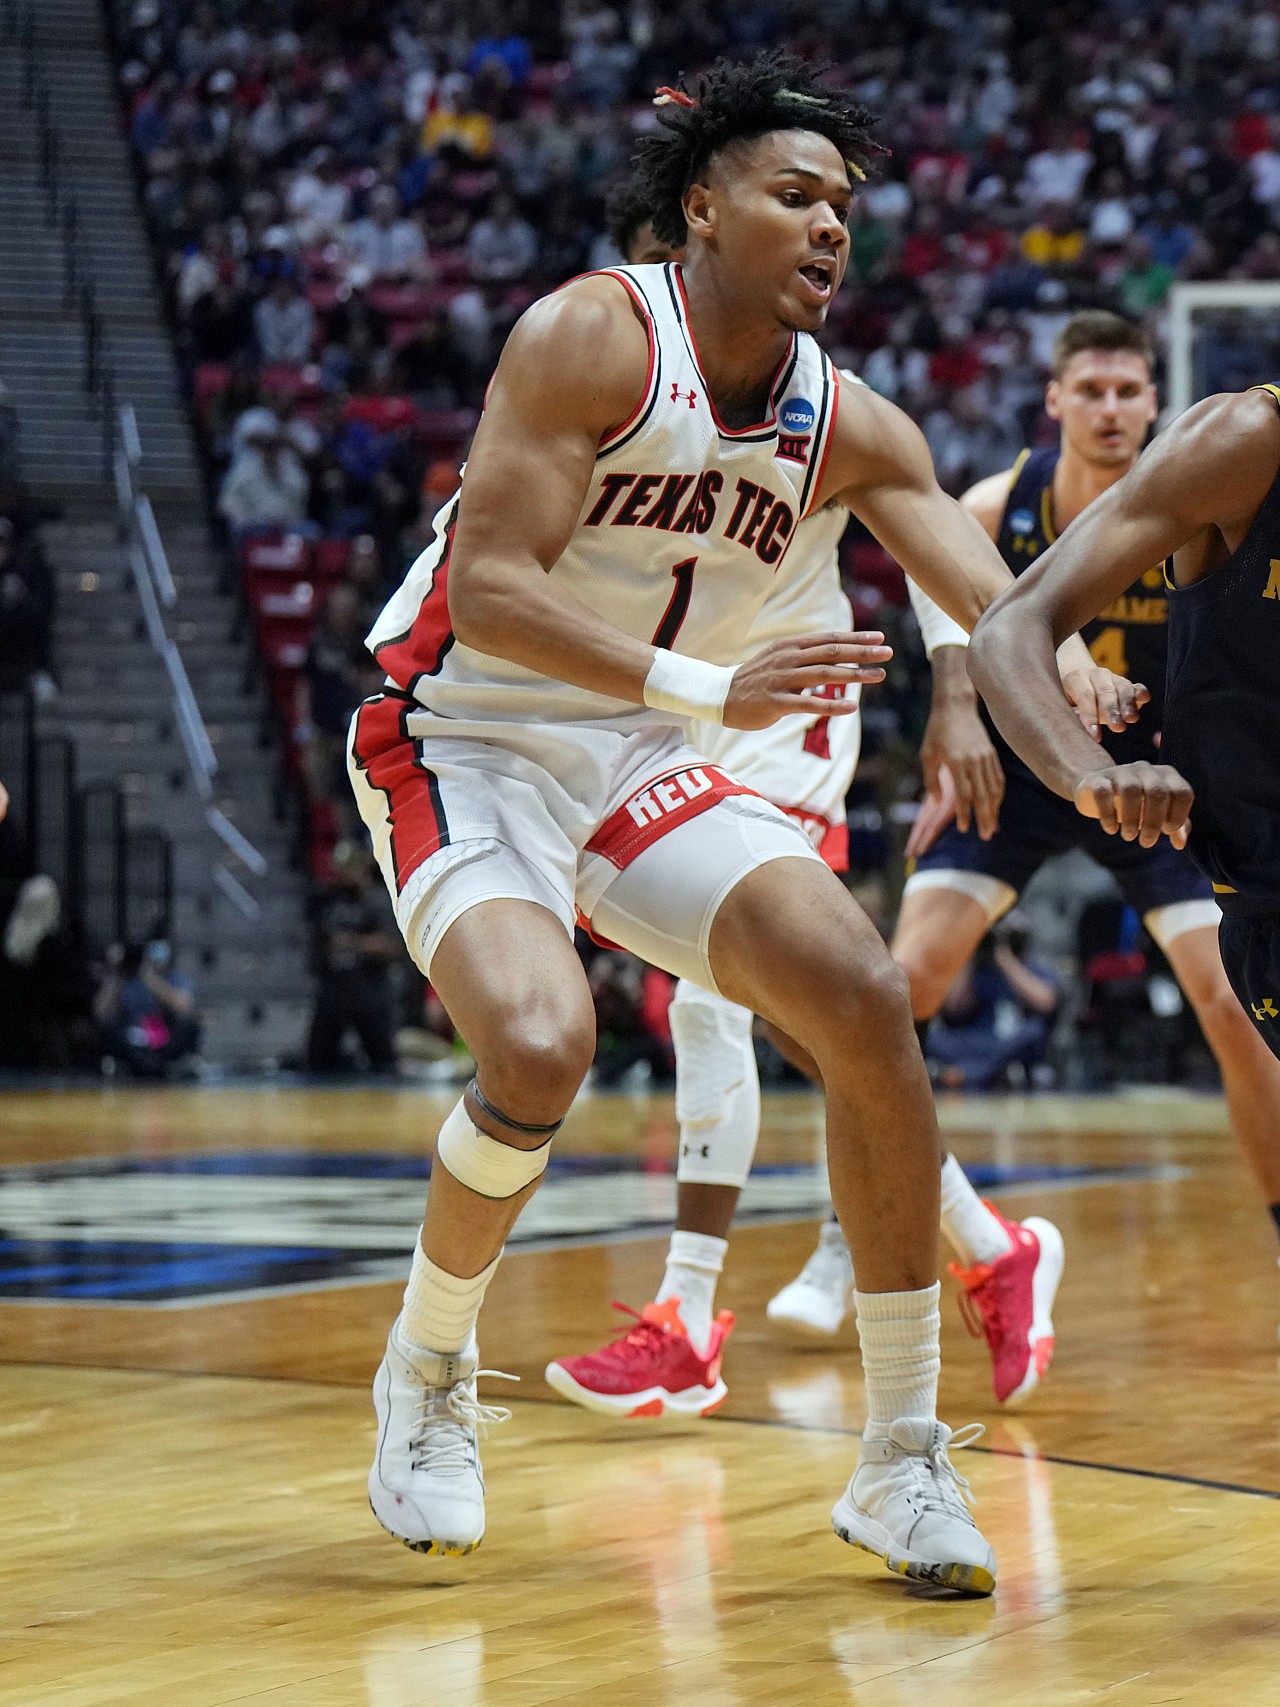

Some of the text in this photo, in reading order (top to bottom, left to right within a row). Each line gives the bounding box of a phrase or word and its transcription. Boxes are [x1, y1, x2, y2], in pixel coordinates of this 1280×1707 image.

[784, 411, 813, 425] NCAA
[583, 470, 800, 573] TEXAS TEC
[650, 556, 699, 651] 1
[624, 767, 713, 829] RED
